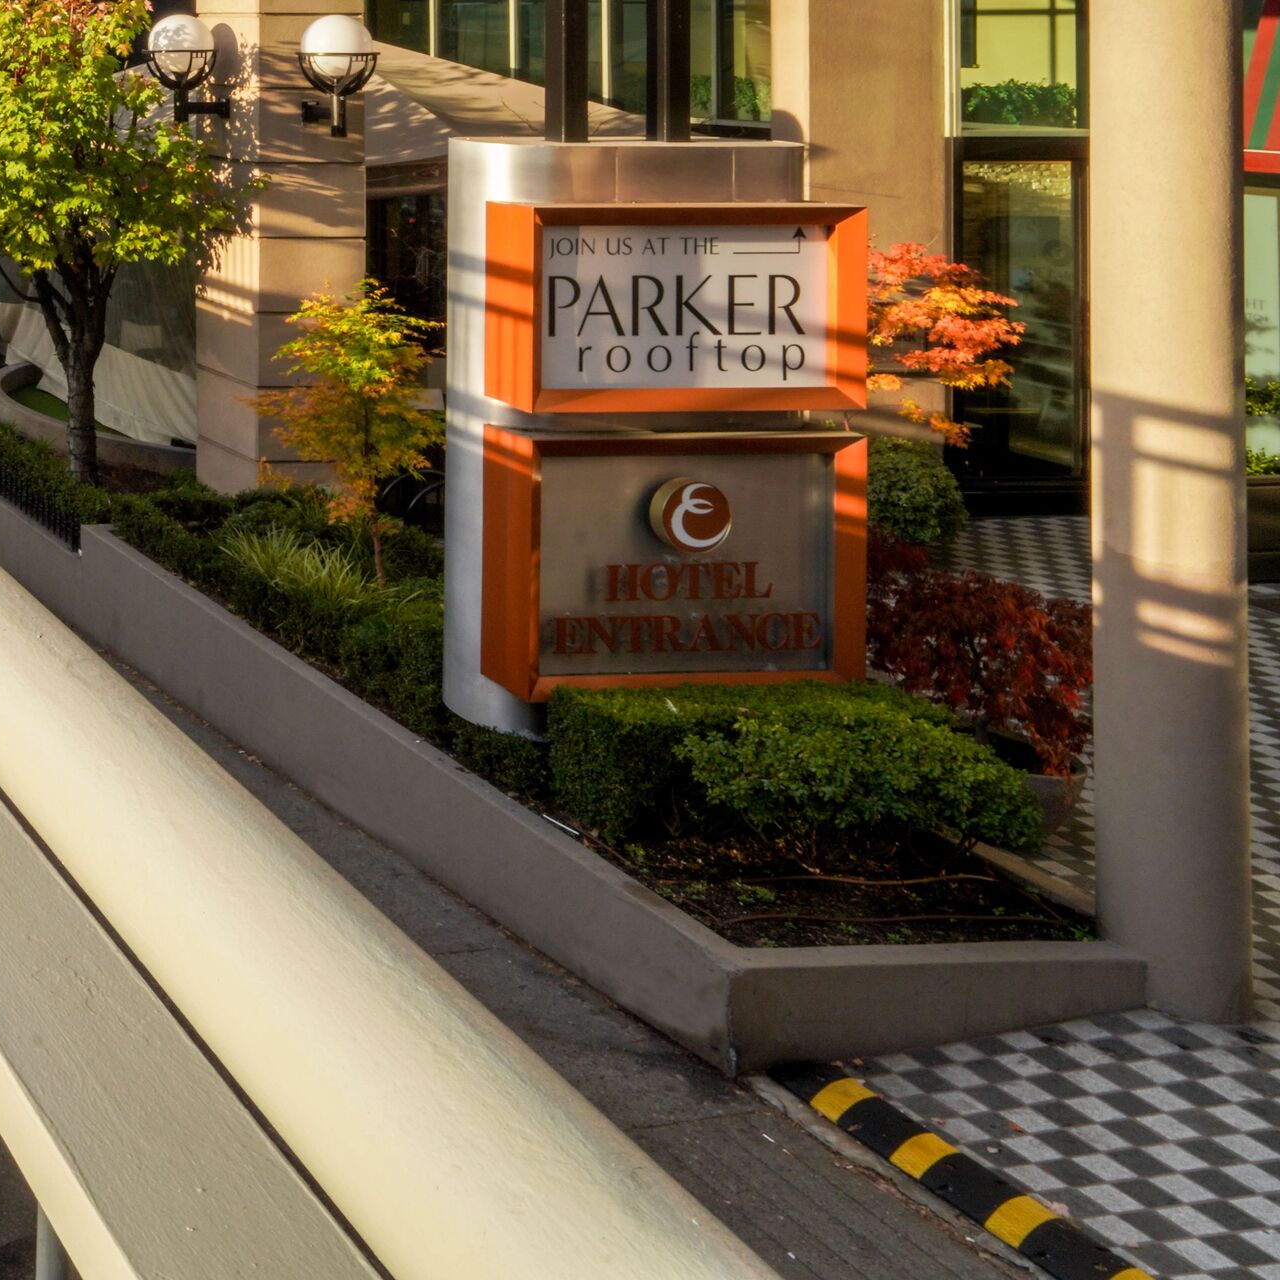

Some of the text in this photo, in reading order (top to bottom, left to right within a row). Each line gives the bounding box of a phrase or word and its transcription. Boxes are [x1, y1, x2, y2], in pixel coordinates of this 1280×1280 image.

[549, 237, 720, 260] JOIN US AT THE
[547, 274, 806, 337] PARKER
[577, 331, 806, 381] rooftop
[605, 561, 773, 603] HOTEL
[552, 612, 822, 655] ENTRANCE
